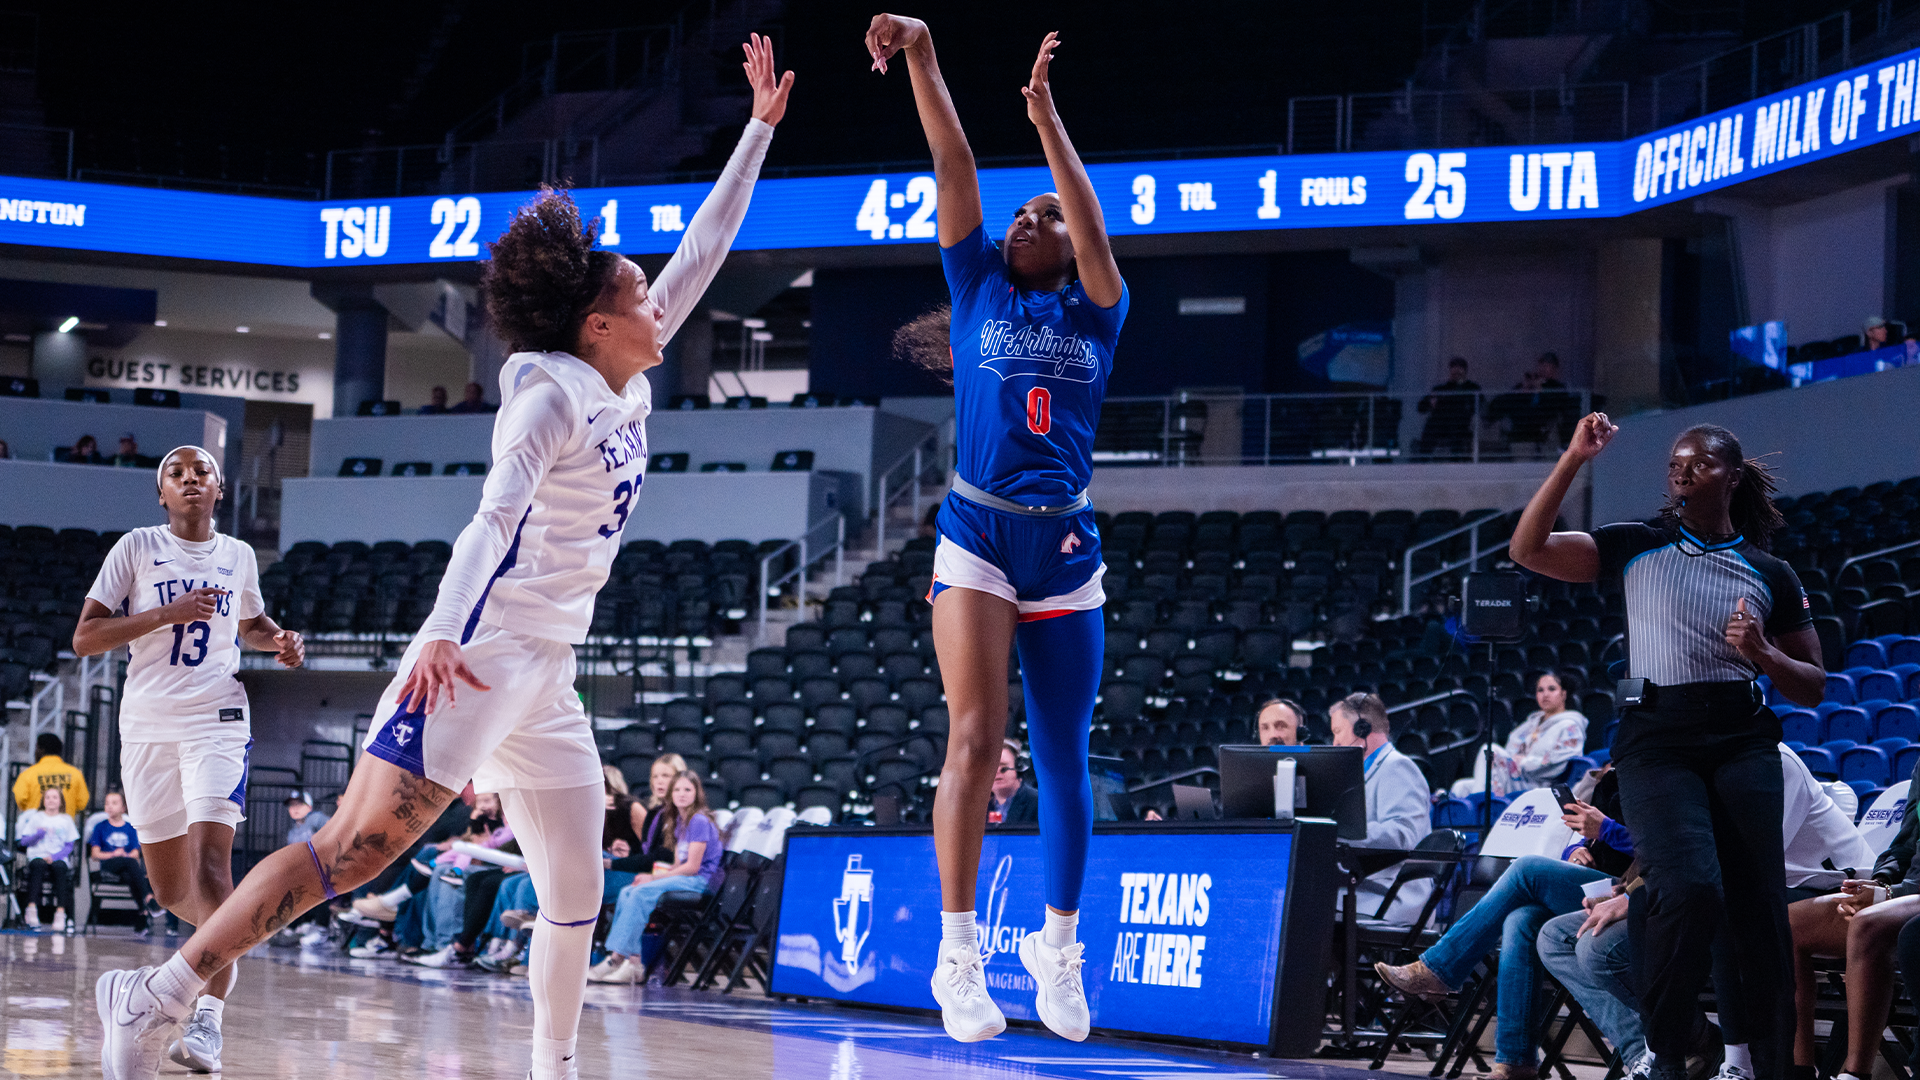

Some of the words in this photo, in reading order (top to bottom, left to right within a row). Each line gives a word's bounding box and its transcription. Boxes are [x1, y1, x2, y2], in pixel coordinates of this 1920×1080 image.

[1633, 113, 1744, 202] OFFICIAL
[1751, 88, 1826, 168] MILK
[1830, 74, 1869, 145] OF
[320, 205, 391, 259] TSU
[429, 197, 481, 258] 22
[599, 199, 620, 246] 1
[650, 204, 685, 232] TOL
[1131, 174, 1156, 225] 3
[1178, 182, 1216, 211] TOL
[1258, 170, 1281, 220] 1
[1301, 176, 1367, 207] FOULS
[1404, 152, 1467, 220] 25
[1509, 151, 1600, 212] UTA
[88, 359, 172, 385] GUEST
[180, 365, 300, 393] SERVICES
[1027, 386, 1051, 435] 0
[153, 579, 233, 617] TENS
[169, 620, 211, 667] 13
[1866, 809, 1891, 821] SEVEN
[1120, 873, 1212, 927] TEXANS
[986, 971, 1039, 992] NAGEMEN
[1110, 932, 1144, 983] ARE
[1141, 933, 1206, 988] HERE
